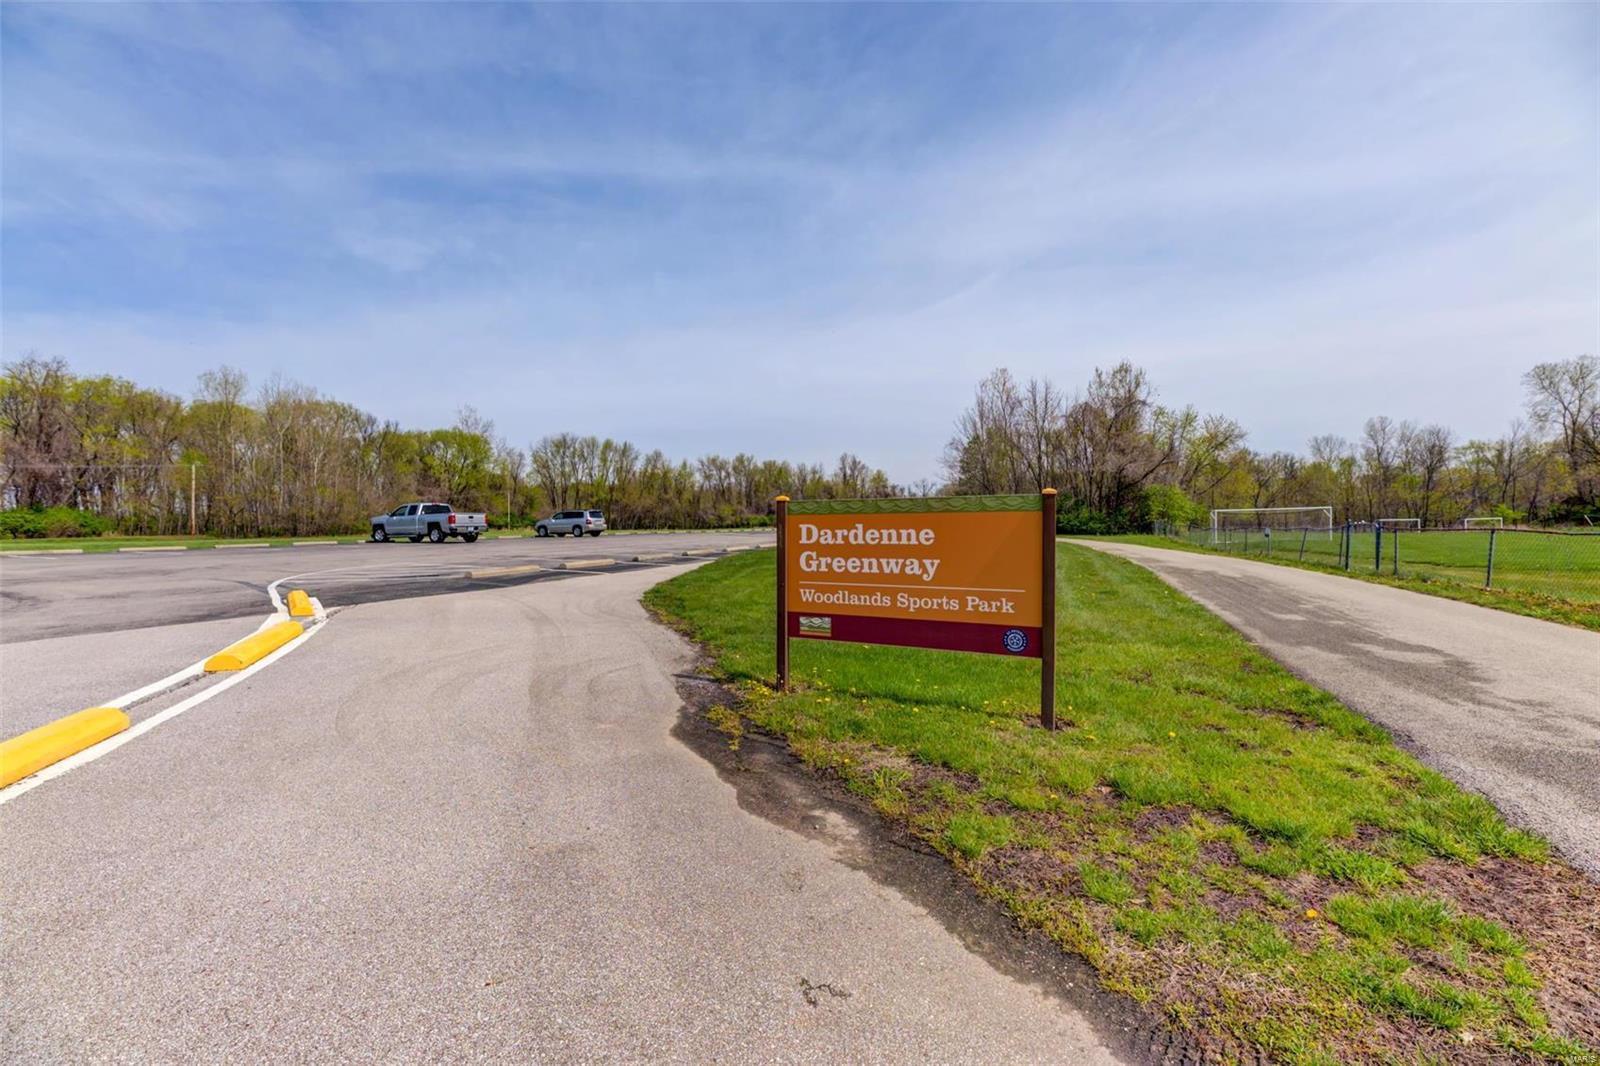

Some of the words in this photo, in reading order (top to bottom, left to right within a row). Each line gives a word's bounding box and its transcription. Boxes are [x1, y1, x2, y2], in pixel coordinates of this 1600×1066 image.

[799, 524, 935, 545] Dardenne
[799, 551, 940, 581] Greenway
[800, 588, 891, 607] Woodlands
[897, 593, 960, 612] Sports
[966, 596, 1015, 614] Park
